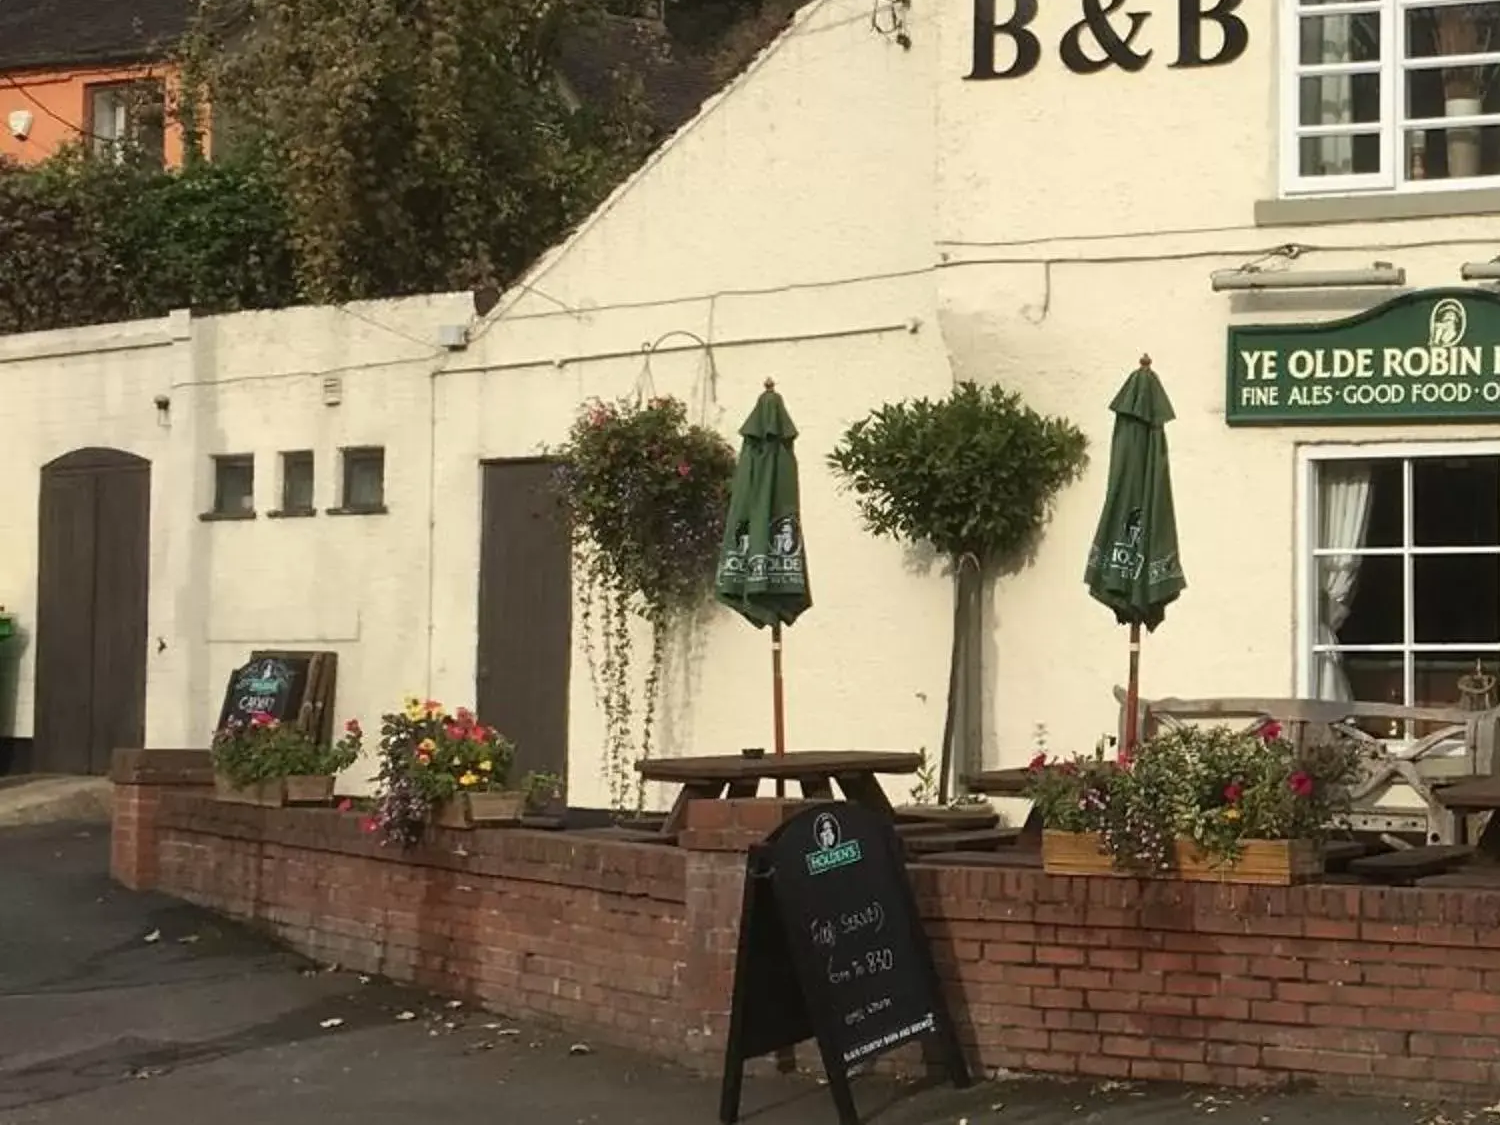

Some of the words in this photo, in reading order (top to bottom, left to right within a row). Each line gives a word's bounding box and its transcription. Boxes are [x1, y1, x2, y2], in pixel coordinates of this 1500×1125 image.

[1240, 350, 1278, 380] YE
[1287, 348, 1374, 379] OLDE
[1383, 346, 1482, 377] ROBIN
[1241, 386, 1279, 406] FINE
[1287, 385, 1333, 406] ALES
[1343, 383, 1405, 404] GOOD
[1411, 382, 1471, 403] FOOD
